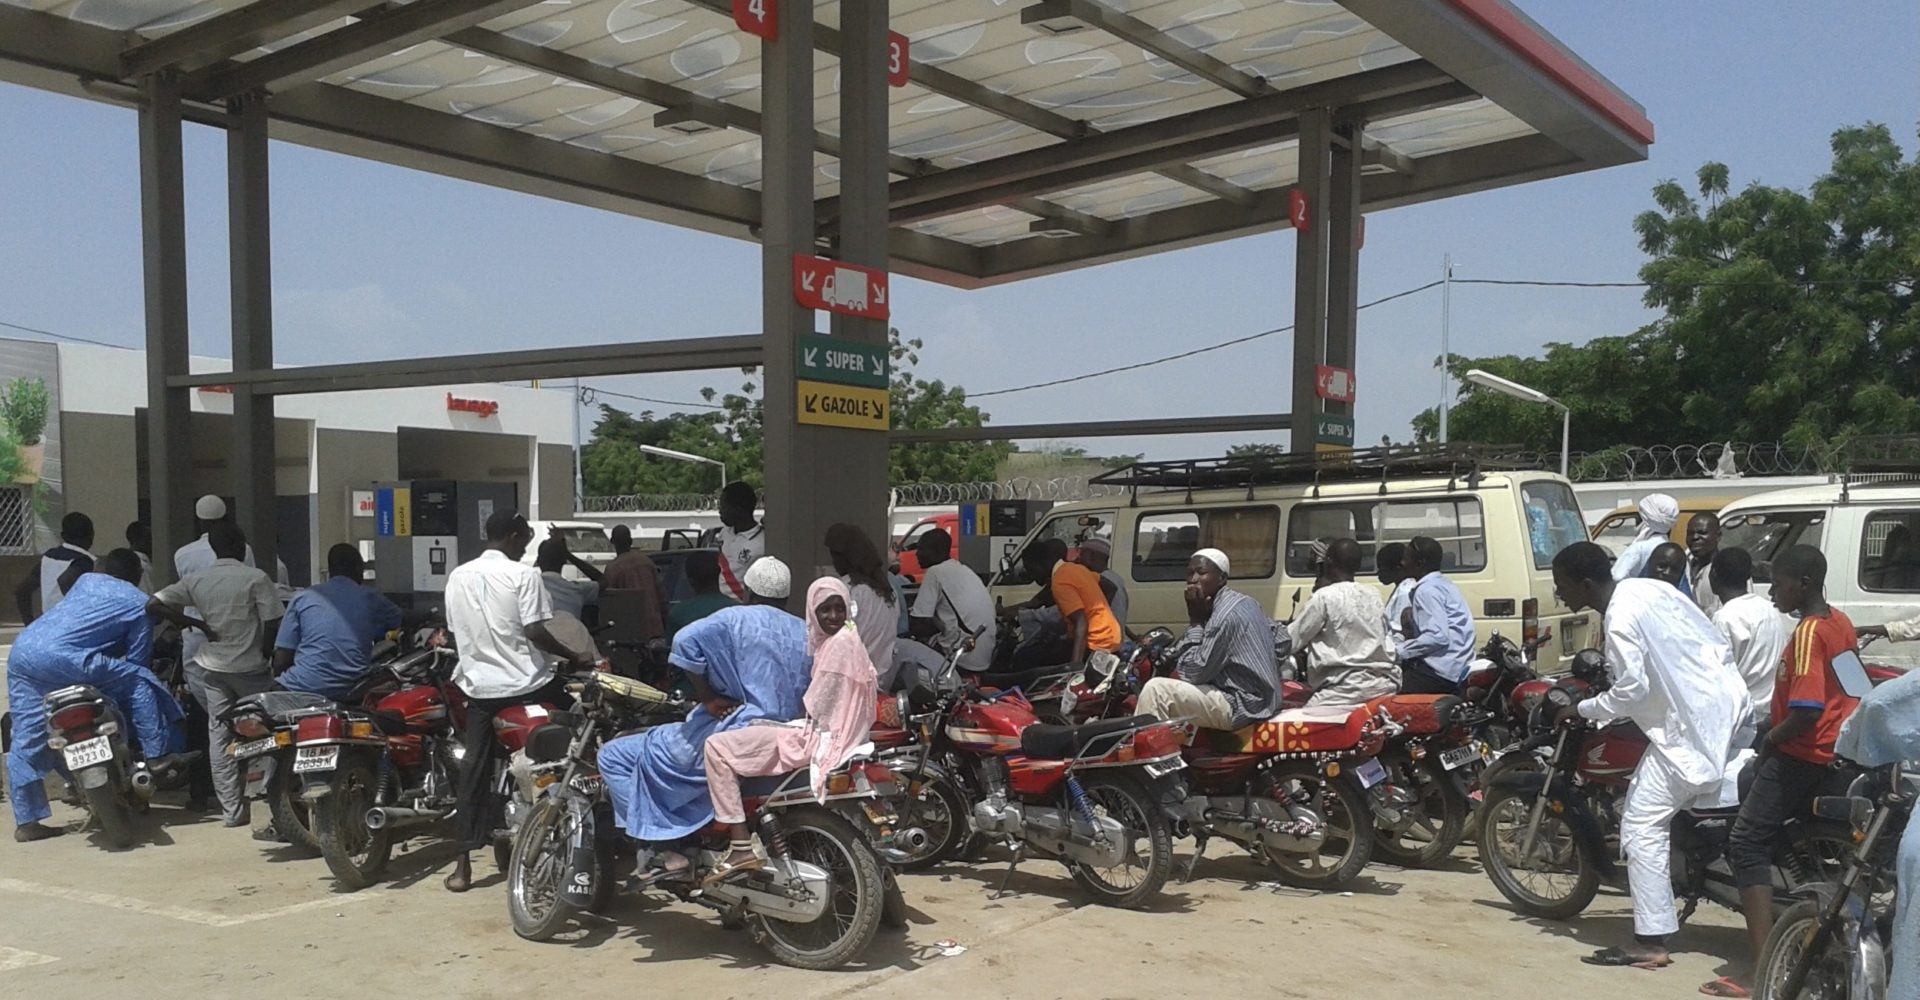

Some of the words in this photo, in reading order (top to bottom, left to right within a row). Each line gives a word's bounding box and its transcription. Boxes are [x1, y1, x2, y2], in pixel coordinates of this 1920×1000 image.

[749, 0, 766, 24] 4
[888, 42, 900, 74] 3
[1298, 199, 1305, 221] 2
[825, 350, 864, 372] SUPER
[821, 395, 869, 417] GAZOLE
[1327, 423, 1344, 437] SUPER
